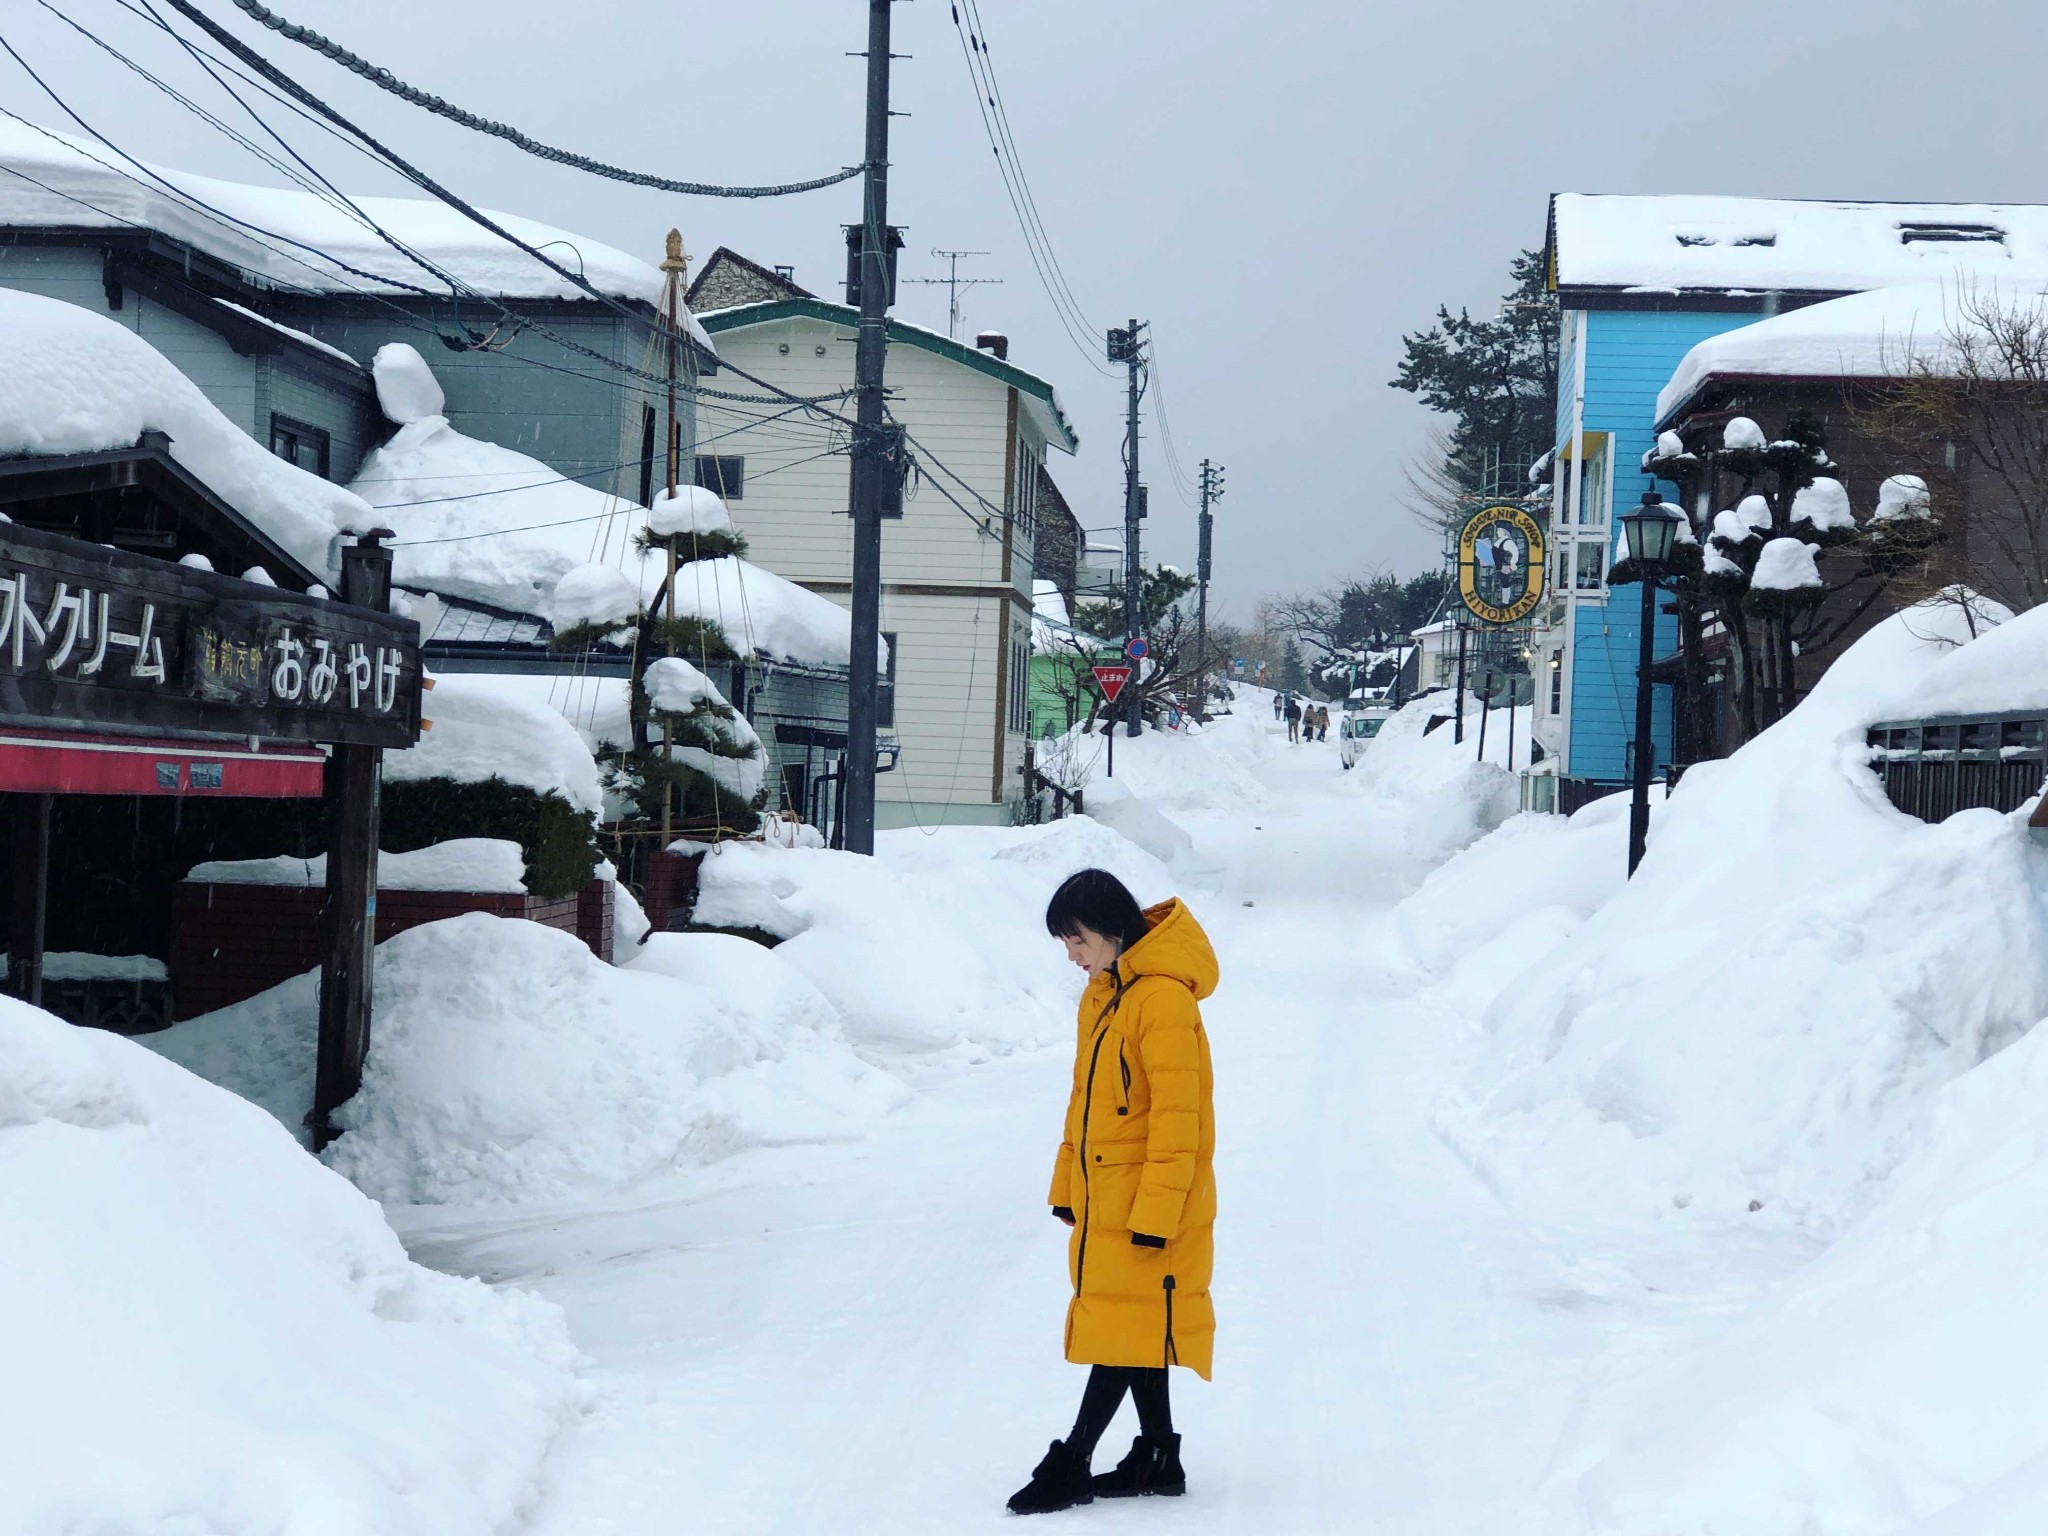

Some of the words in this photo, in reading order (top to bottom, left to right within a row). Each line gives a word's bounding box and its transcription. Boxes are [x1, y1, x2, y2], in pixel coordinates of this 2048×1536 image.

[1463, 508, 1519, 548] SOUVENIR
[1518, 517, 1541, 548] SHOP
[1465, 590, 1537, 621] HIYORIKAN
[271, 626, 402, 713] おみやげ
[1100, 673, 1124, 682] 止まれ
